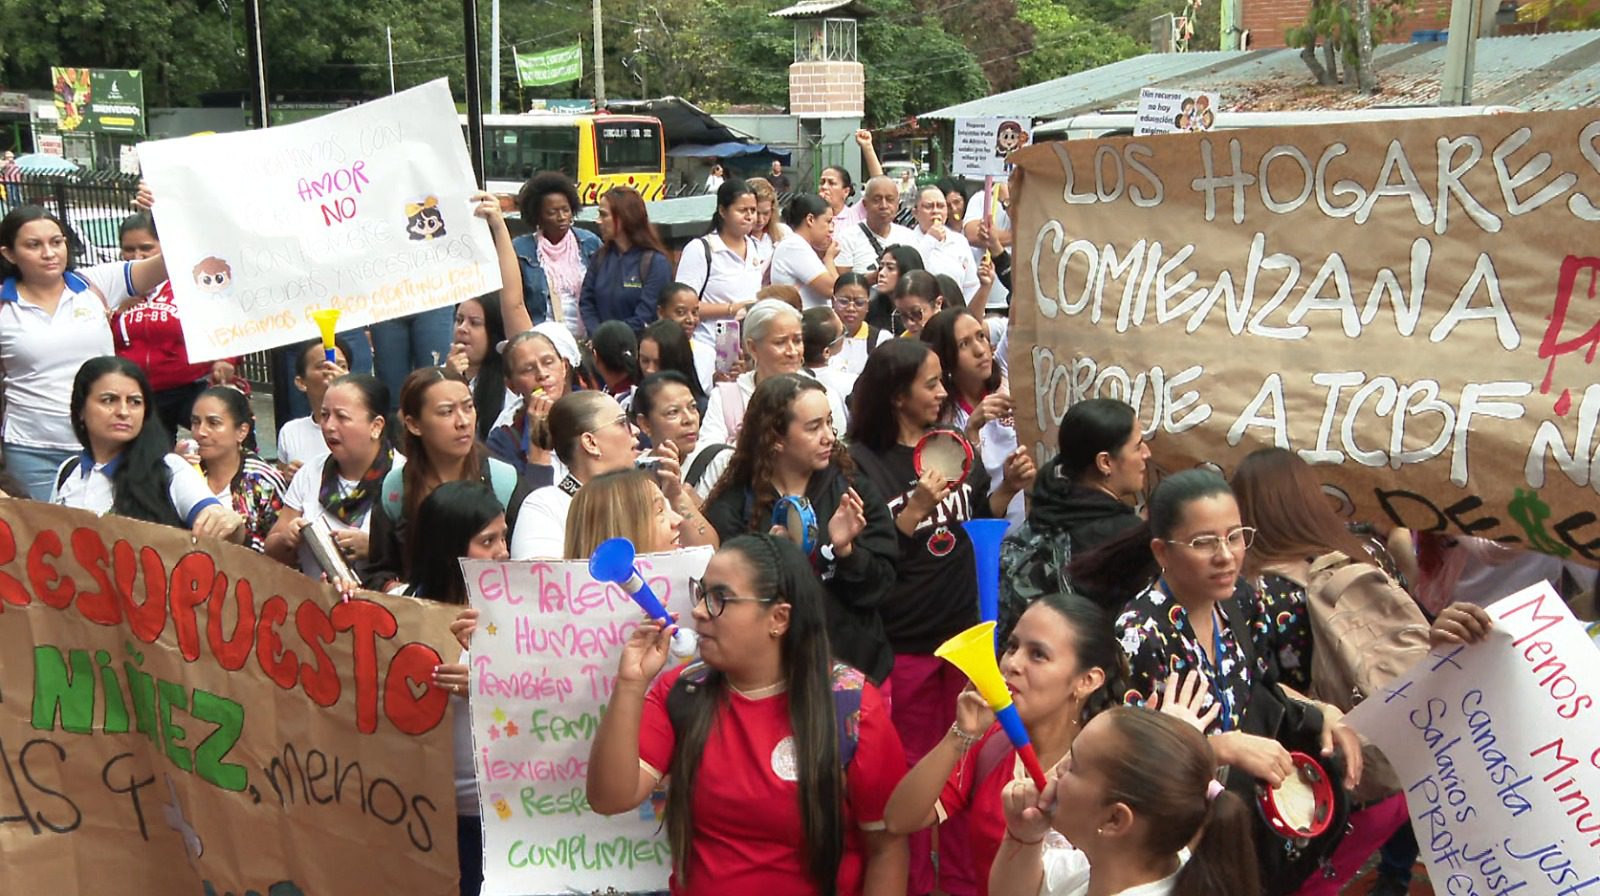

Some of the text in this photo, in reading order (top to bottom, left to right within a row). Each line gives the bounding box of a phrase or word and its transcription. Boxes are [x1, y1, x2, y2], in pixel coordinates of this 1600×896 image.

[297, 160, 370, 202] AMOR
[320, 196, 357, 227] NO
[1053, 119, 1600, 236] LOS HOGARES
[1031, 218, 1431, 340] COMIENZAN
[1430, 251, 1520, 351] A
[1227, 373, 1289, 450] A
[1298, 370, 1534, 488] ICBF
[479, 564, 524, 606] EL
[474, 655, 573, 703] TAMBIÉN
[1499, 593, 1593, 719] Menos
